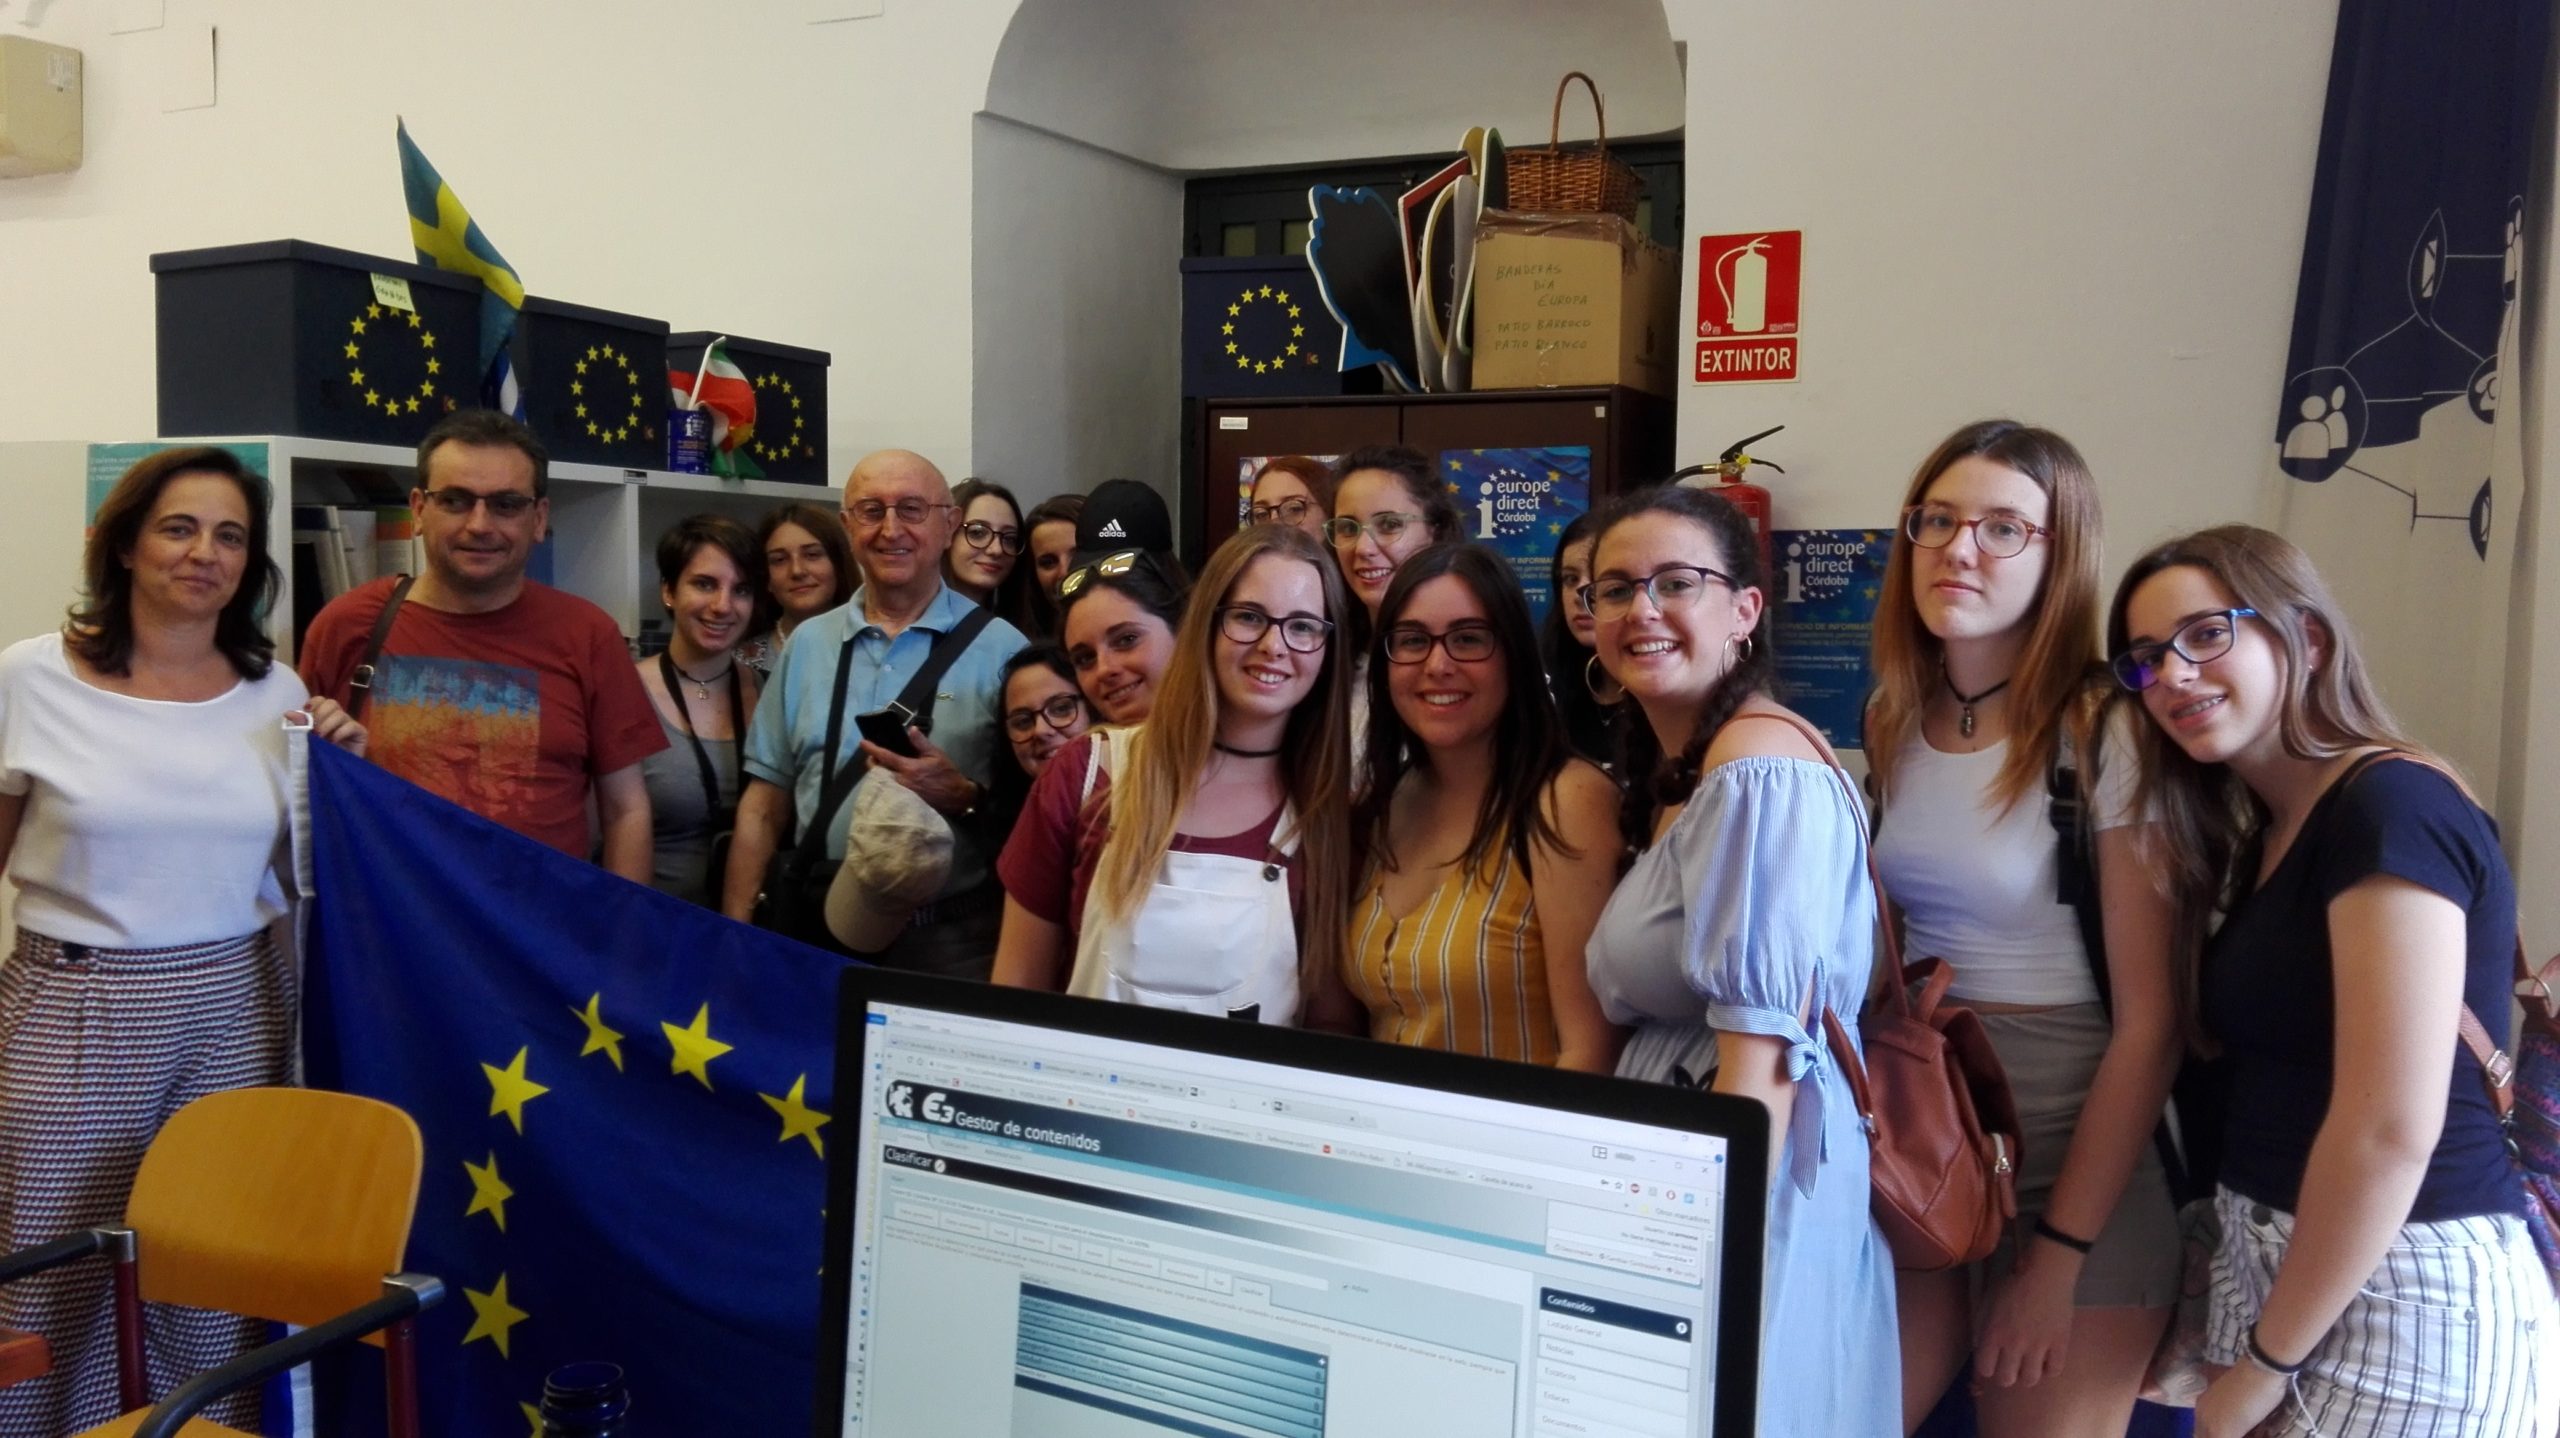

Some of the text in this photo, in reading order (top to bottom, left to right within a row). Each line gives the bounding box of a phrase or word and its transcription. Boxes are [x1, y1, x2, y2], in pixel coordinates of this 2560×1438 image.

[1537, 294, 1588, 307] EUROPA
[1497, 319, 1592, 333] PATIO BARROCO
[1495, 340, 1529, 351] PATIO
[1700, 347, 1791, 373] EXTINTOR
[1497, 481, 1551, 496] europe
[1496, 494, 1540, 510] direct
[1497, 512, 1536, 522] Córdoba
[1806, 542, 1865, 559] europe
[1806, 557, 1854, 573] direct
[1806, 574, 1849, 586] Córdoba
[955, 1112, 1001, 1132] Gestor
[1003, 1120, 1022, 1137] de
[1024, 1125, 1101, 1152] contenidos
[885, 1147, 933, 1168] Clasificar
[1546, 1294, 1596, 1314] Contenidos
